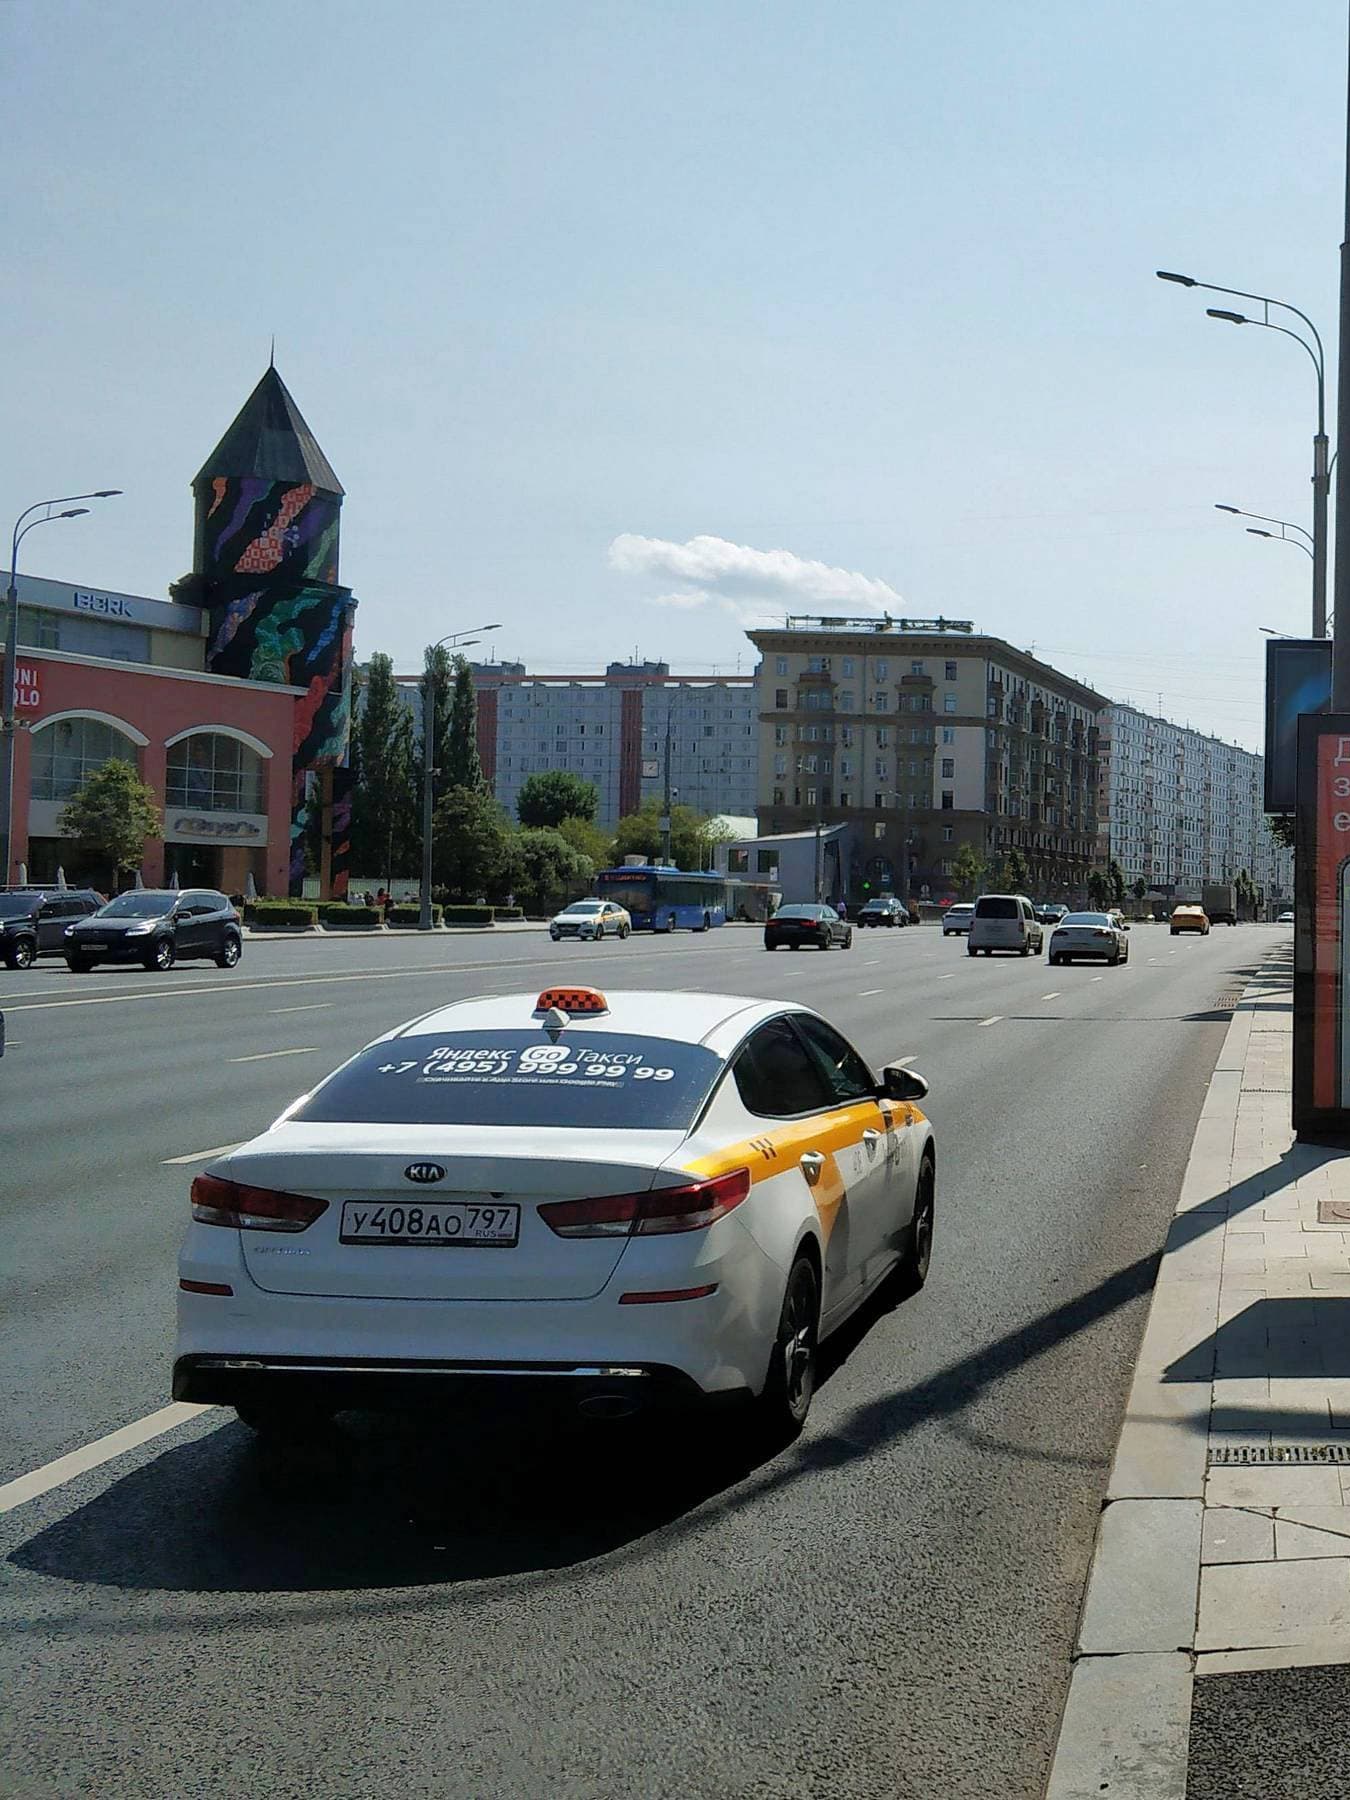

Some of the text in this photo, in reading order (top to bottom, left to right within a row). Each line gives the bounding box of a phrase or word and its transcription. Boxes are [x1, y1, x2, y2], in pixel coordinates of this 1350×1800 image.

[427, 1047, 517, 1060] Яндекс
[576, 1049, 643, 1065] Такси
[378, 1060, 675, 1081] +7 (495) 999 99 99
[410, 1166, 440, 1179] KIA
[468, 1208, 511, 1230] 797
[475, 1229, 497, 1238] RUS
